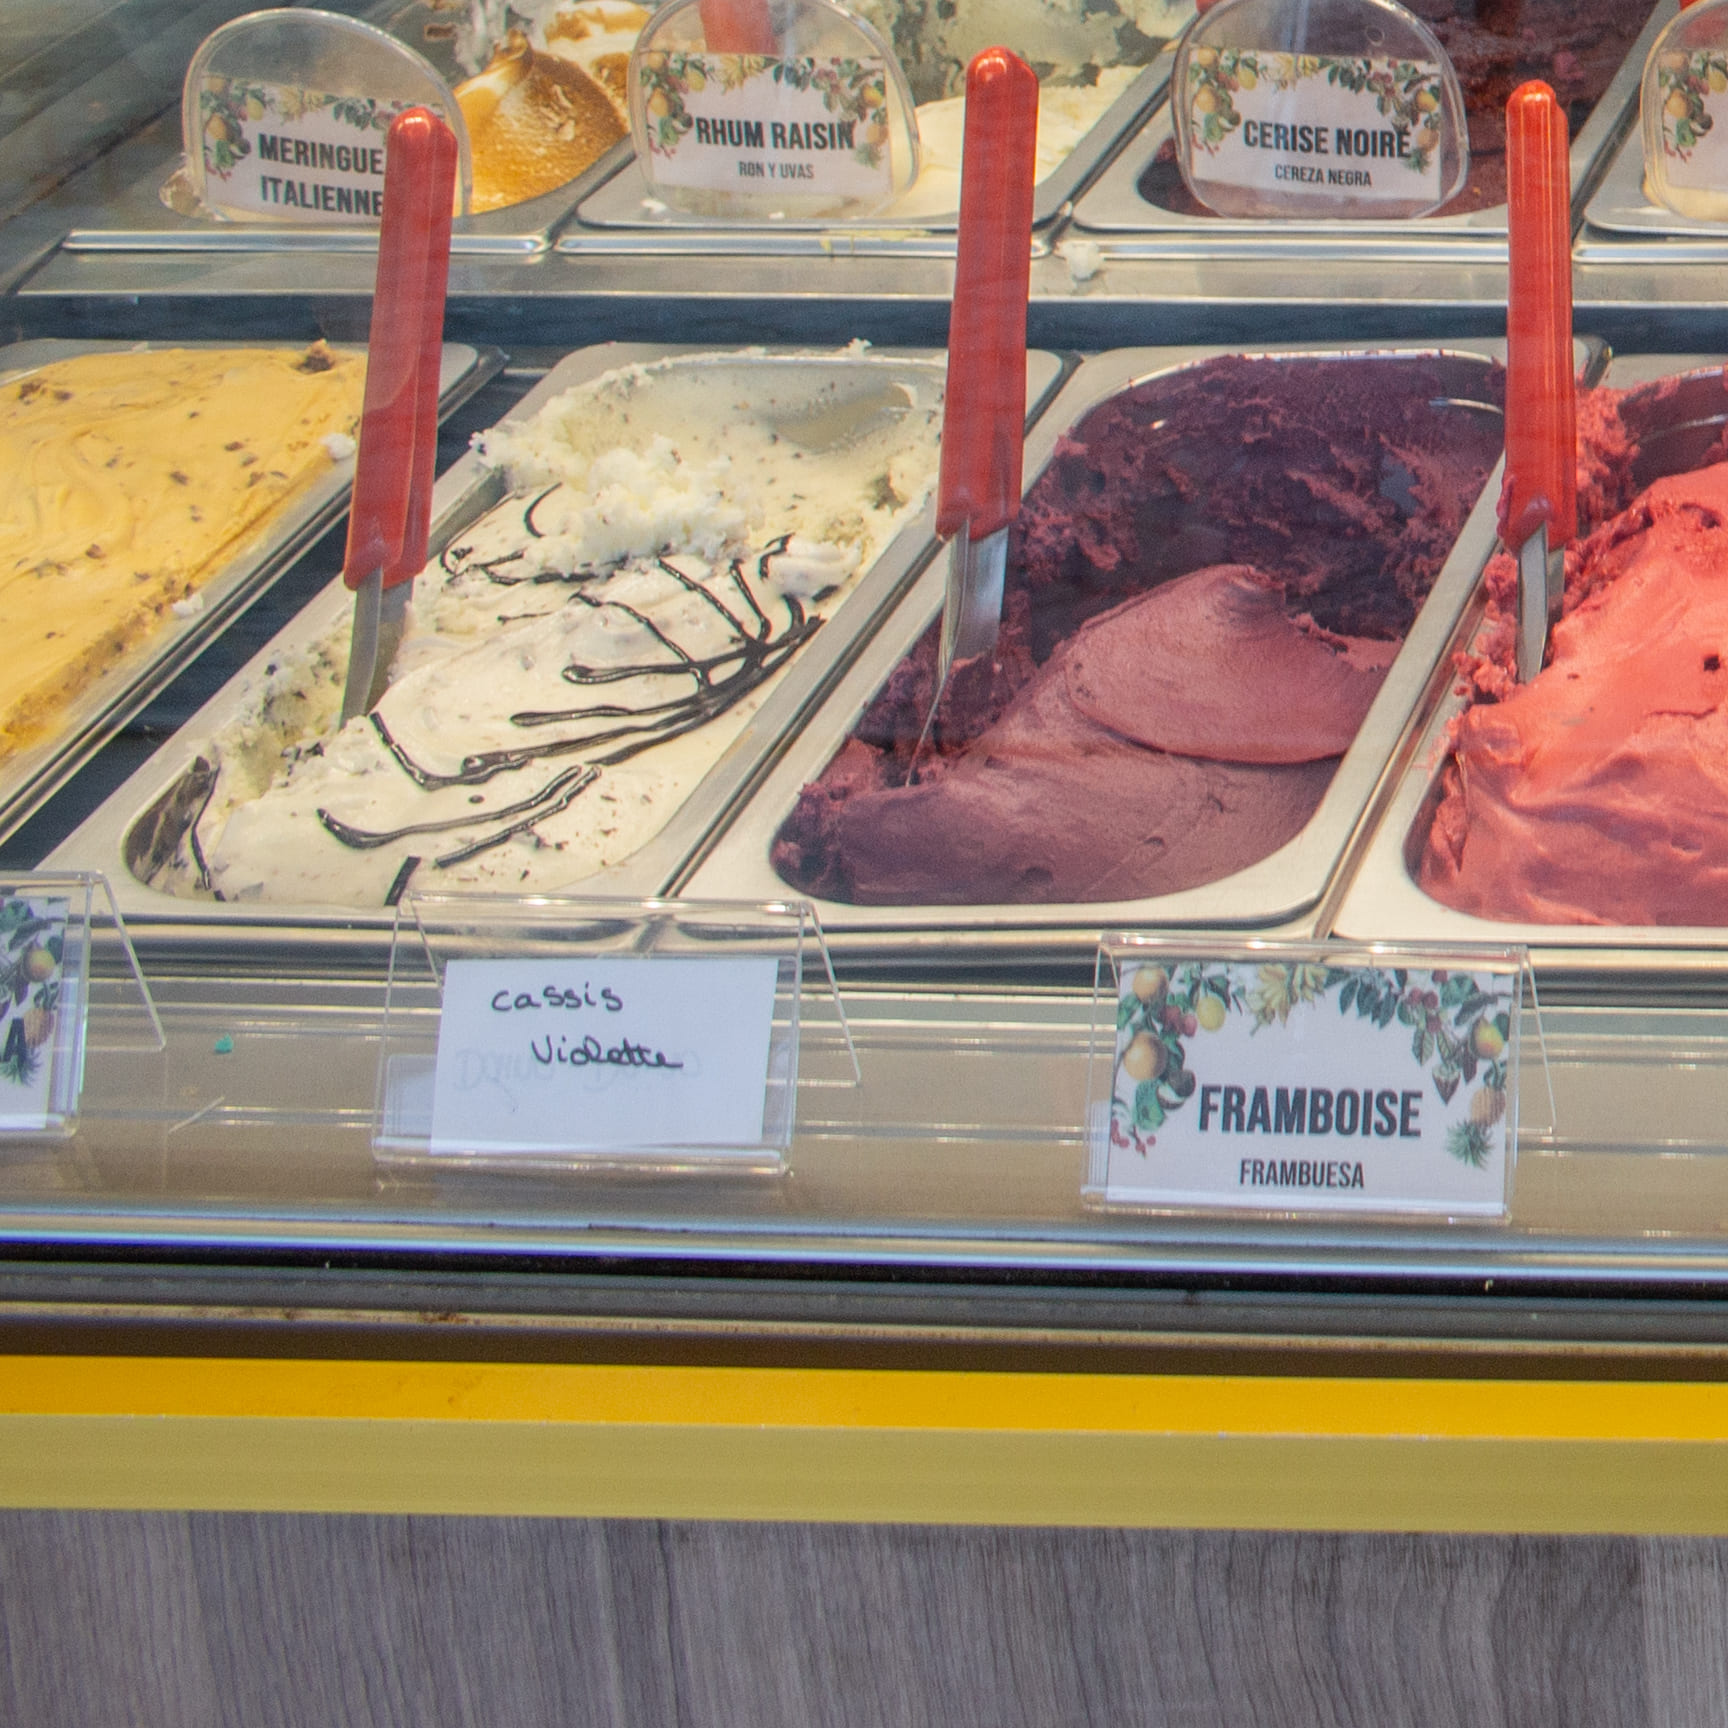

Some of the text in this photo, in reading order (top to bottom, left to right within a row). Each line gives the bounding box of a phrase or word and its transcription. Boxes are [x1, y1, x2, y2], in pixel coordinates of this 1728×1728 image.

[695, 117, 857, 151] RHUM RAISIN
[1244, 119, 1412, 159] CERISE NOIRE
[258, 133, 385, 175] MERINGUE
[738, 161, 815, 180] RON Y UVAS
[1274, 164, 1373, 188] CEREZA NEGRA
[260, 175, 384, 217] ITALIENNE
[1198, 1084, 1424, 1139] FRAMBOISE
[1239, 1158, 1365, 1189] FRAMBUESA
